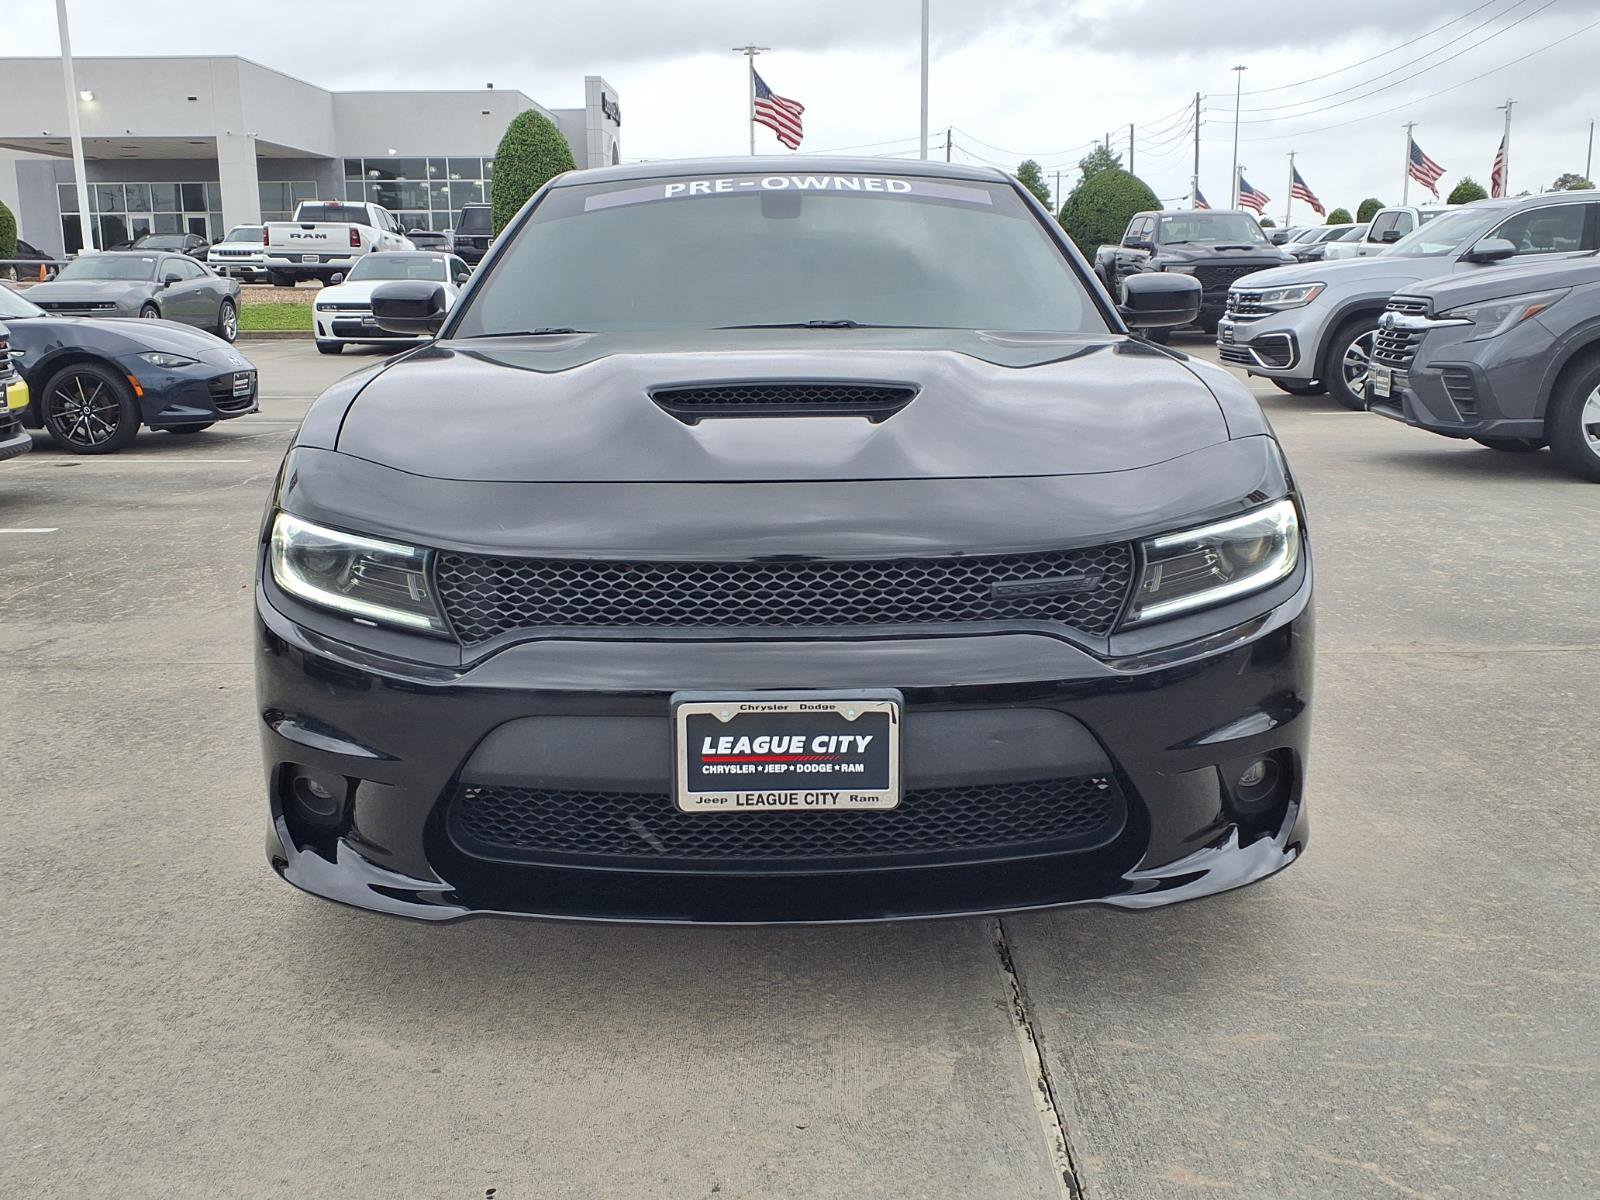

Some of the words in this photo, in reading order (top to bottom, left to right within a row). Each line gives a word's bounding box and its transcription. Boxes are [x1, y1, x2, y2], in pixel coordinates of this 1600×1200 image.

[664, 176, 912, 198] PRE-OWNED
[701, 736, 806, 754] LEAGUE
[811, 735, 874, 753] CITY
[702, 764, 756, 774] CHRYSLER
[764, 764, 788, 773] JEEP
[796, 763, 833, 773] DODGE
[841, 763, 865, 773] RAM
[695, 796, 728, 804] Jeep
[736, 793, 799, 806] LEAGUE
[804, 792, 840, 805] CITY
[849, 794, 880, 802] Ram
